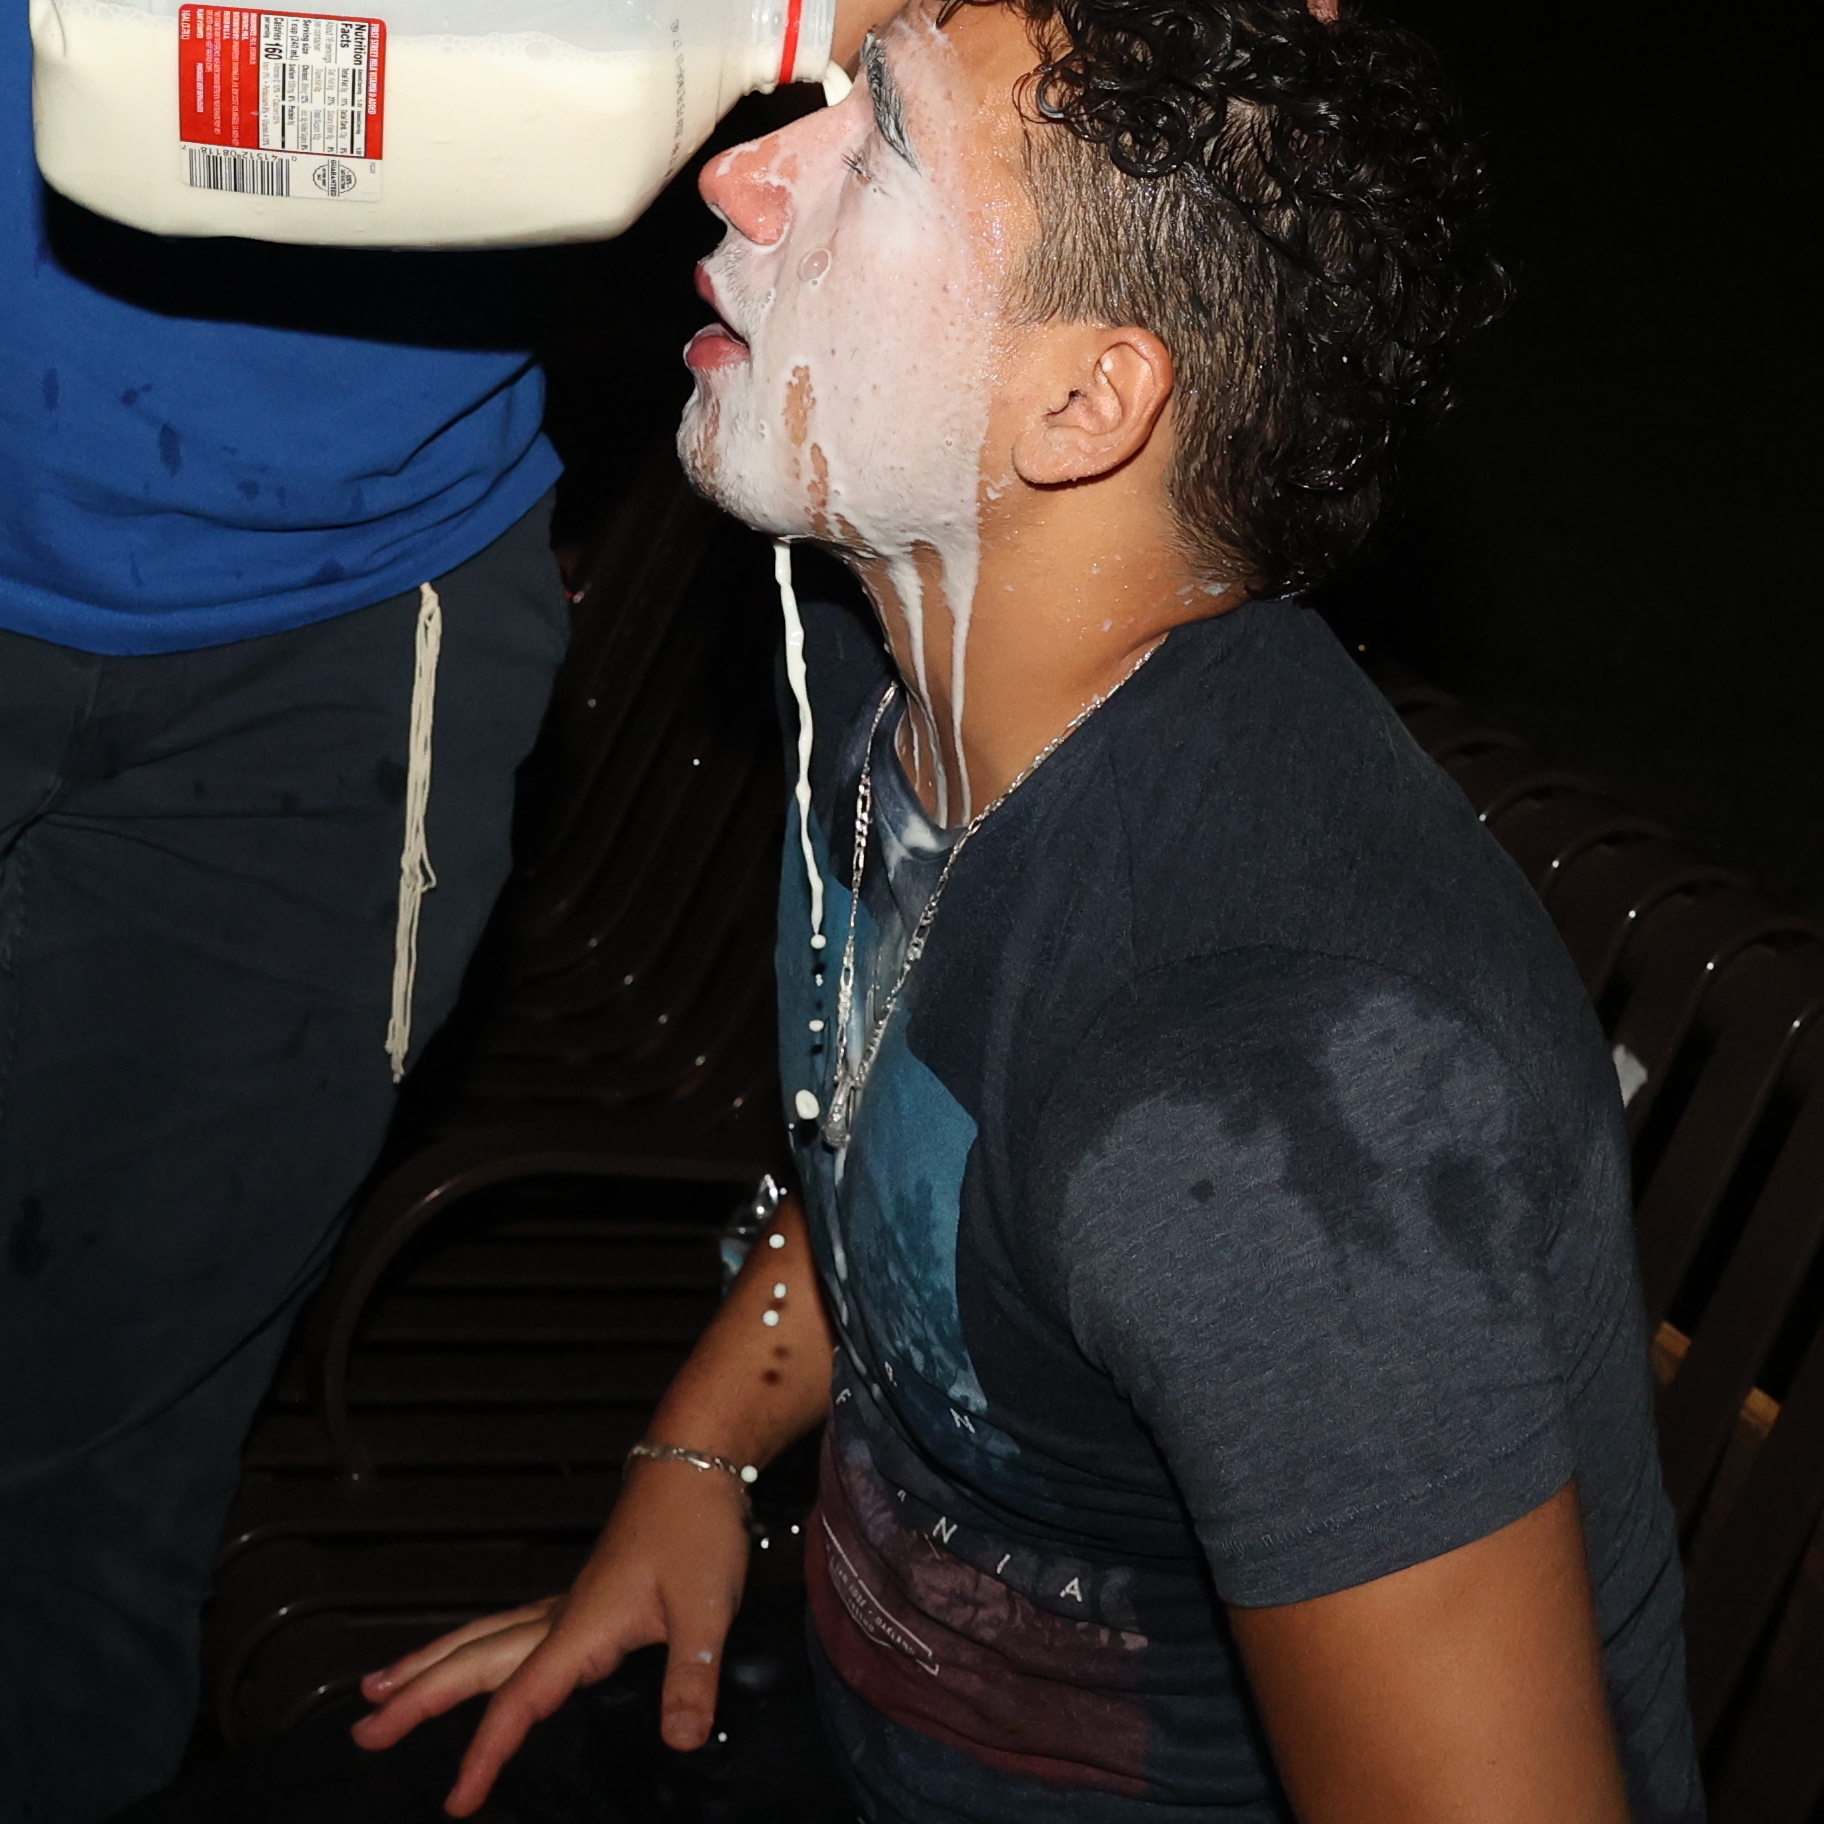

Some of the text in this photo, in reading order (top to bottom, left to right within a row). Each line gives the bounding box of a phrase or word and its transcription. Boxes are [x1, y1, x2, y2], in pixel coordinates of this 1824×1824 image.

[265, 18, 284, 60] Calories 160
[290, 24, 298, 34] cup
[301, 20, 311, 54] Serving size
[341, 23, 352, 48] Facts
[289, 36, 299, 48] (240
[354, 24, 366, 65] Nutrition
[289, 50, 298, 60] mL)
